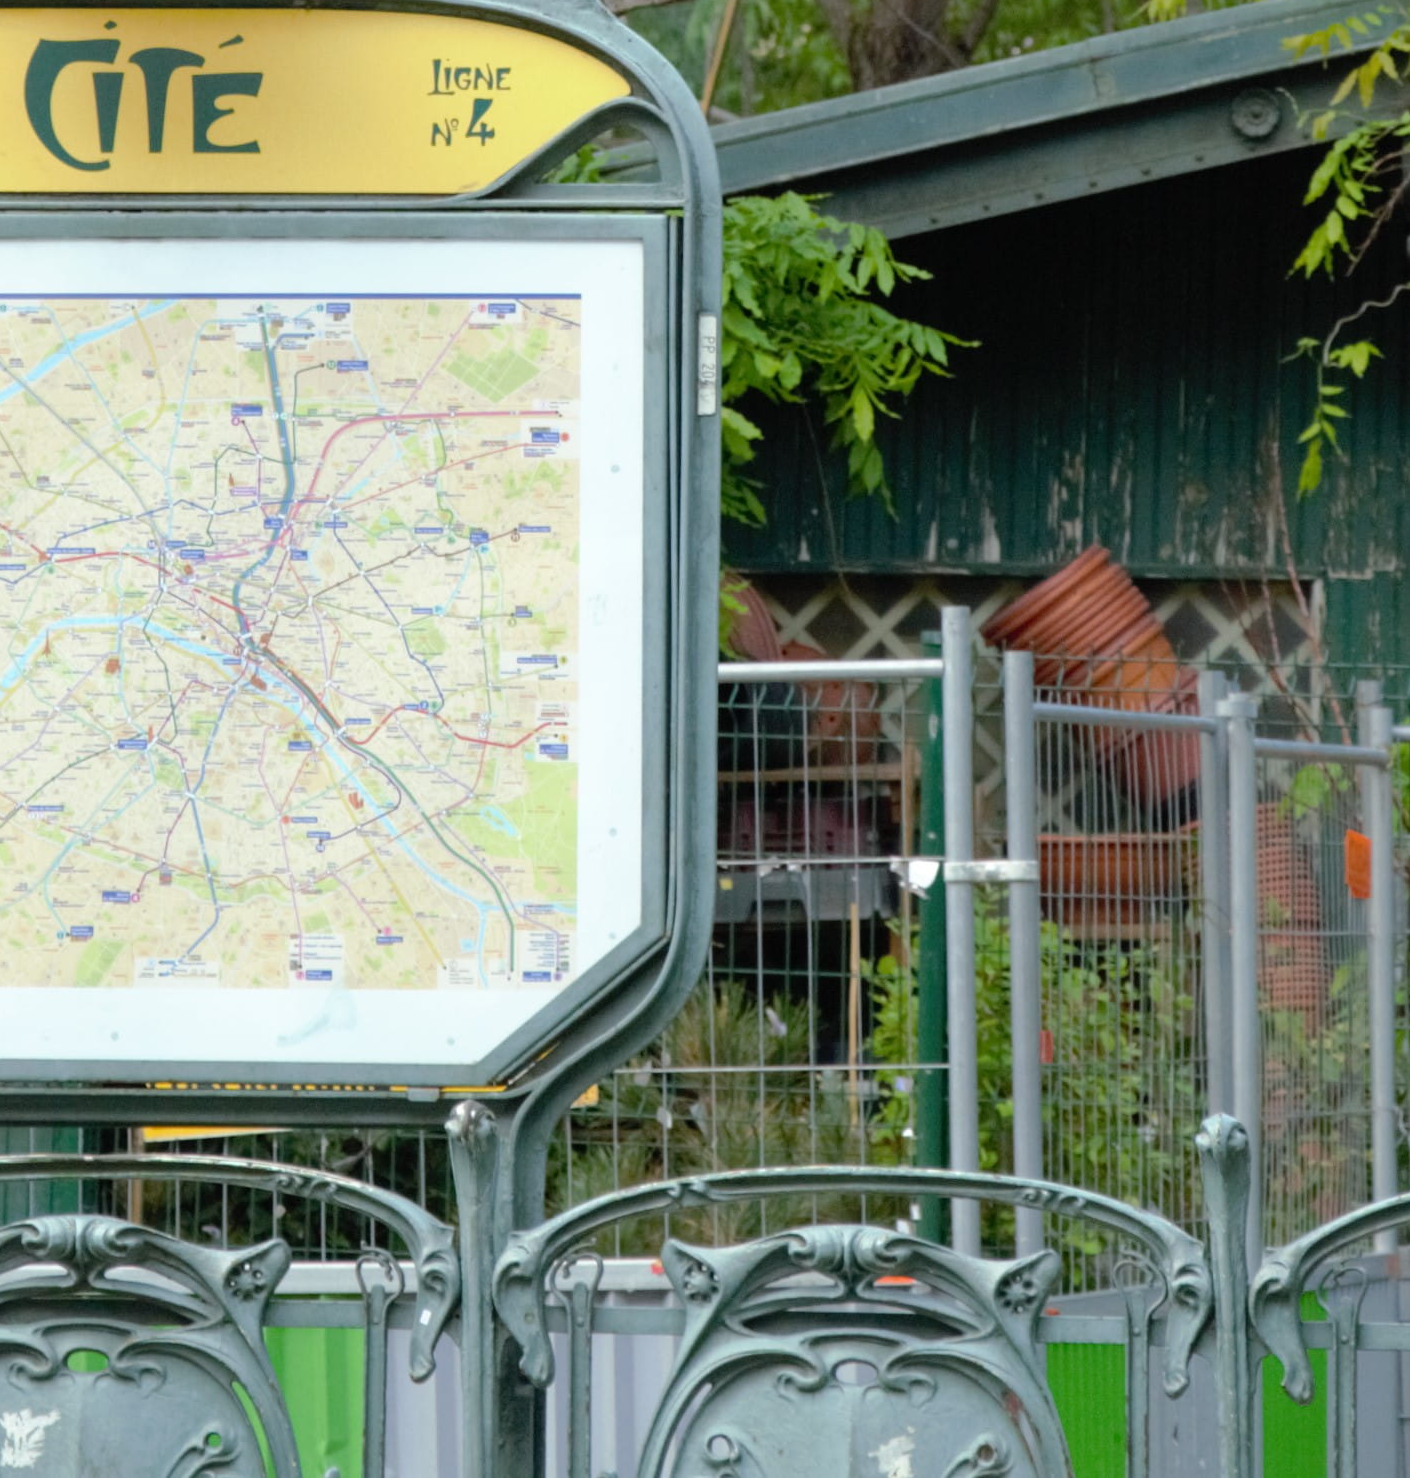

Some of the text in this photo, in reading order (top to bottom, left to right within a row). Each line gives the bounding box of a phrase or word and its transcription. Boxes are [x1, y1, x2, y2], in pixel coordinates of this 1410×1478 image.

[24, 20, 264, 172] CITÉ
[429, 57, 511, 97] LIGNE
[465, 98, 496, 146] 4
